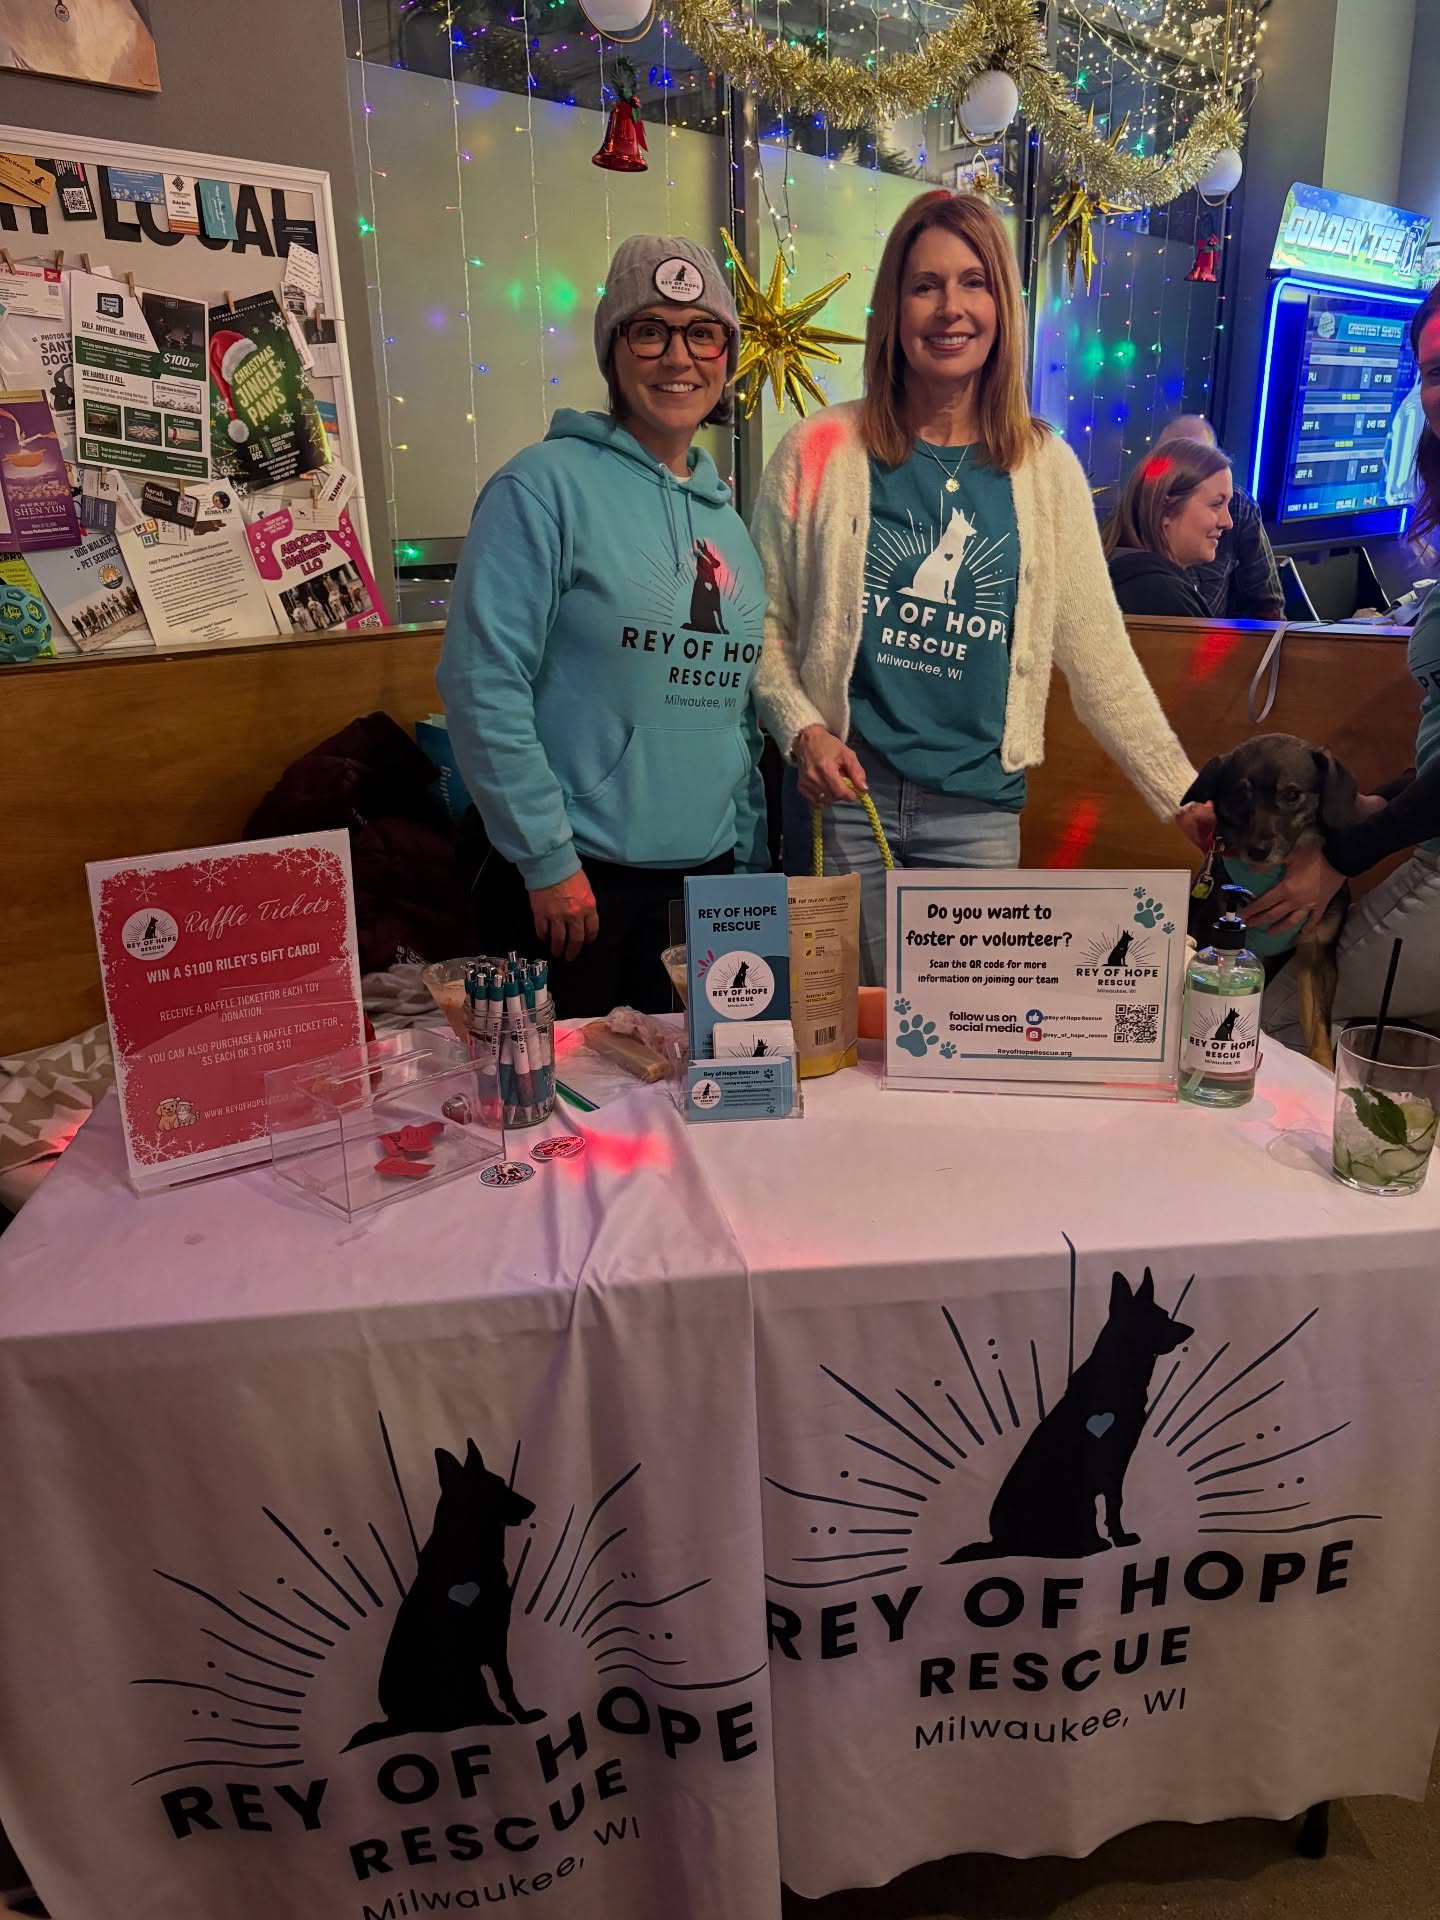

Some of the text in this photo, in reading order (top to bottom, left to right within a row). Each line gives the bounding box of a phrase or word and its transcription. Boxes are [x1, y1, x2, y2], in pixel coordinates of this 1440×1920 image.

[1284, 205, 1407, 266] GOLDEN TEE
[162, 352, 190, 366] $100
[234, 345, 275, 384] CHRISTMAS
[90, 371, 108, 380] HANDLE
[236, 358, 282, 408] JINGLE
[246, 386, 287, 427] PAWS
[248, 444, 260, 454] 7TH
[251, 450, 264, 461] DEC
[328, 474, 347, 502] ELINSKI
[14, 506, 43, 517] SHEN
[44, 504, 66, 514] YUN
[74, 534, 113, 558] DOG WALKER
[80, 546, 121, 570] PET SERVICES
[861, 592, 890, 617] EY
[899, 602, 936, 628] OF
[621, 626, 762, 664] REY OF HOP
[881, 628, 968, 660] RESCUE
[668, 666, 742, 688] RESCUE
[876, 652, 964, 680] Milwaukee, WI
[664, 694, 736, 709] Milwaukee, WI
[184, 893, 333, 941] Raffle Tickets
[698, 906, 777, 920] REY OF HOPE
[927, 904, 1052, 924] Do you want to
[712, 920, 760, 932] RESCUE
[156, 936, 176, 944] HOPE
[906, 930, 1073, 948] foster or volunteer?
[146, 942, 320, 984] WIN A $100 RILEY'S GIFT CARD!
[929, 958, 1047, 969] Scan the QR code for more
[1076, 968, 1158, 977] REY OF HOPE
[918, 974, 1059, 986] information on joining our team
[160, 1007, 194, 1022] RECEIVE
[196, 1004, 203, 1015] A
[204, 998, 236, 1014] RAFFLE
[282, 986, 303, 998] EACH
[304, 982, 320, 994] TOY
[949, 1010, 1017, 1022] follow us on
[949, 1022, 1024, 1033] social media
[148, 1017, 338, 1065] YOU CAN ALSO PURCHASE A RAFFLE TICKET FOR
[202, 1038, 292, 1067] $5 EACH OR 3 FOR $10
[1189, 1036, 1256, 1050] REY OF HOPE
[1206, 1051, 1240, 1059] RESCUE
[766, 1539, 1354, 1661] REY OF HOPE
[919, 1625, 1192, 1698] RESCUE
[915, 1687, 1187, 1750] Milwaukee, WI
[160, 1685, 758, 1839] REY OF HOPE
[348, 1758, 628, 1881] RESCUE
[362, 1815, 640, 1920] Milwaukee, WI
